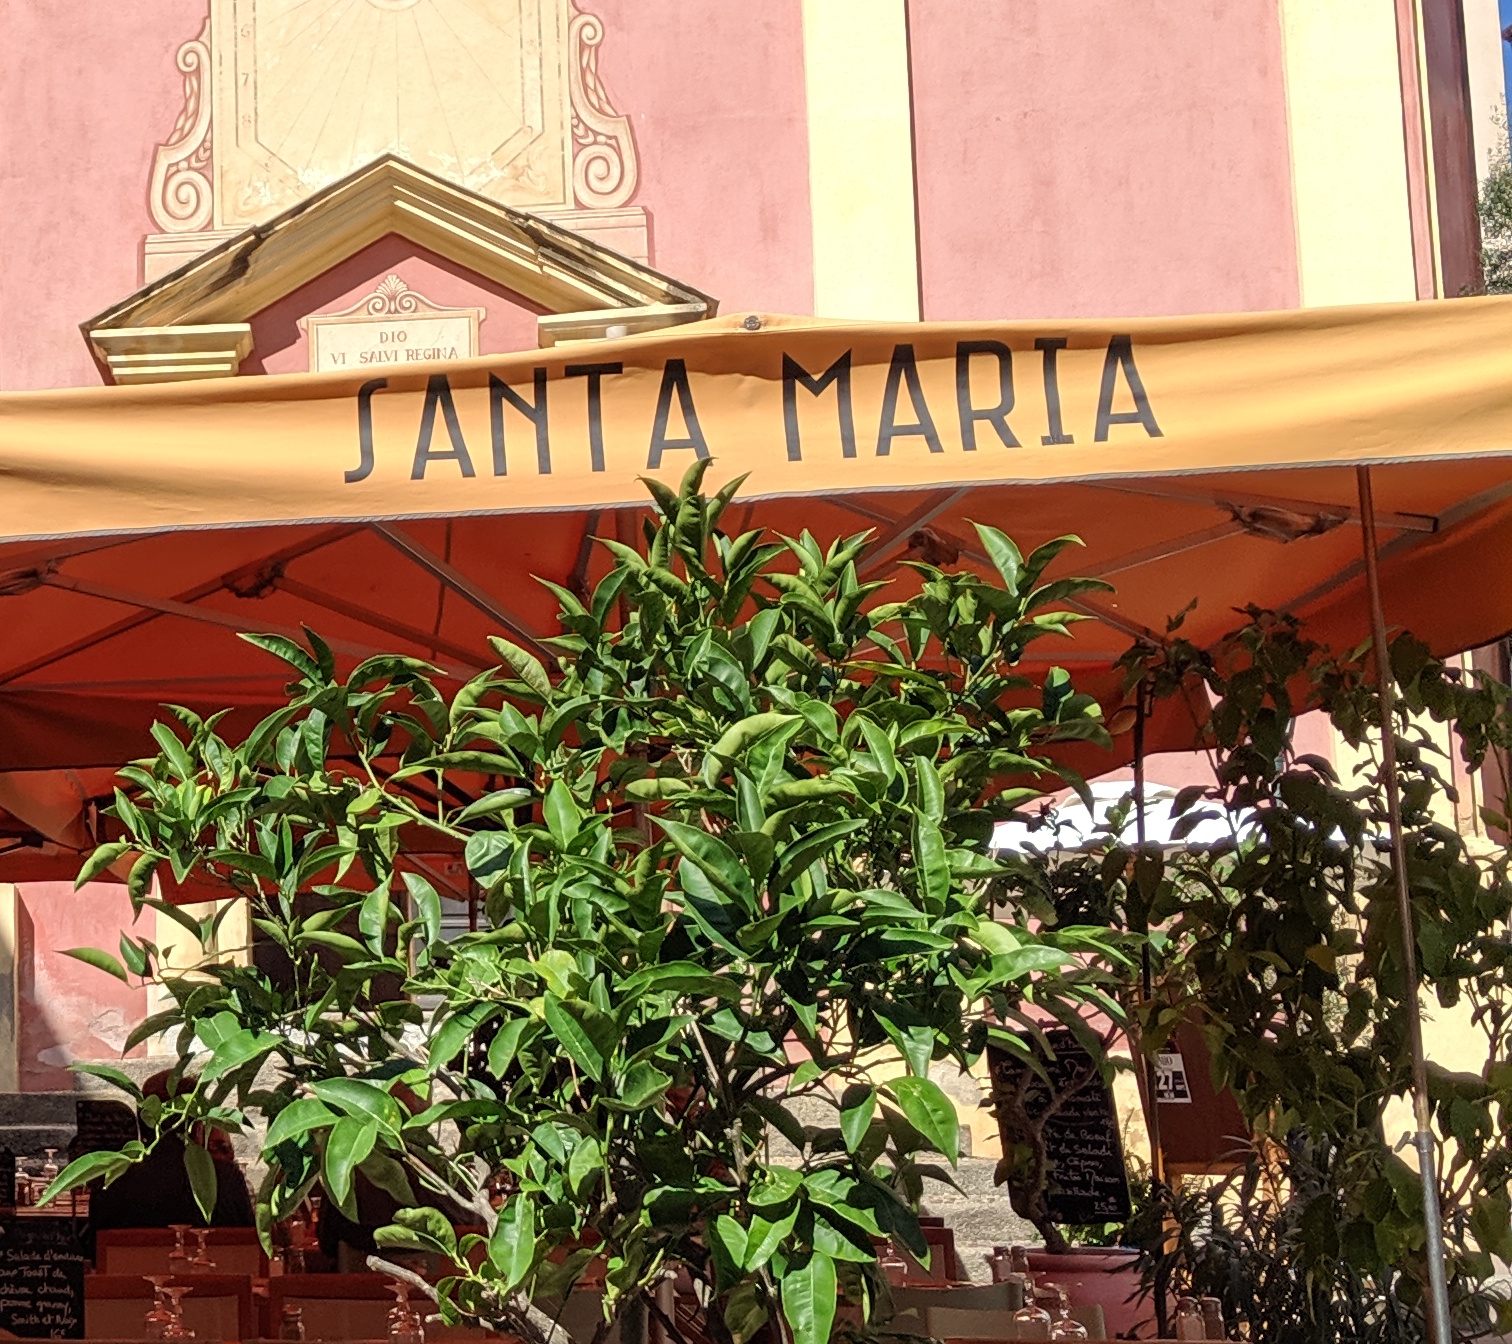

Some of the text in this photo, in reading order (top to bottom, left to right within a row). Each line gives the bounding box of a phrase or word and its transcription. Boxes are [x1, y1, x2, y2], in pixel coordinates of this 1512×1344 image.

[379, 330, 408, 344] DIO
[330, 345, 459, 365] VI SALVI REGINA
[344, 334, 1165, 484] SANTA MARIA
